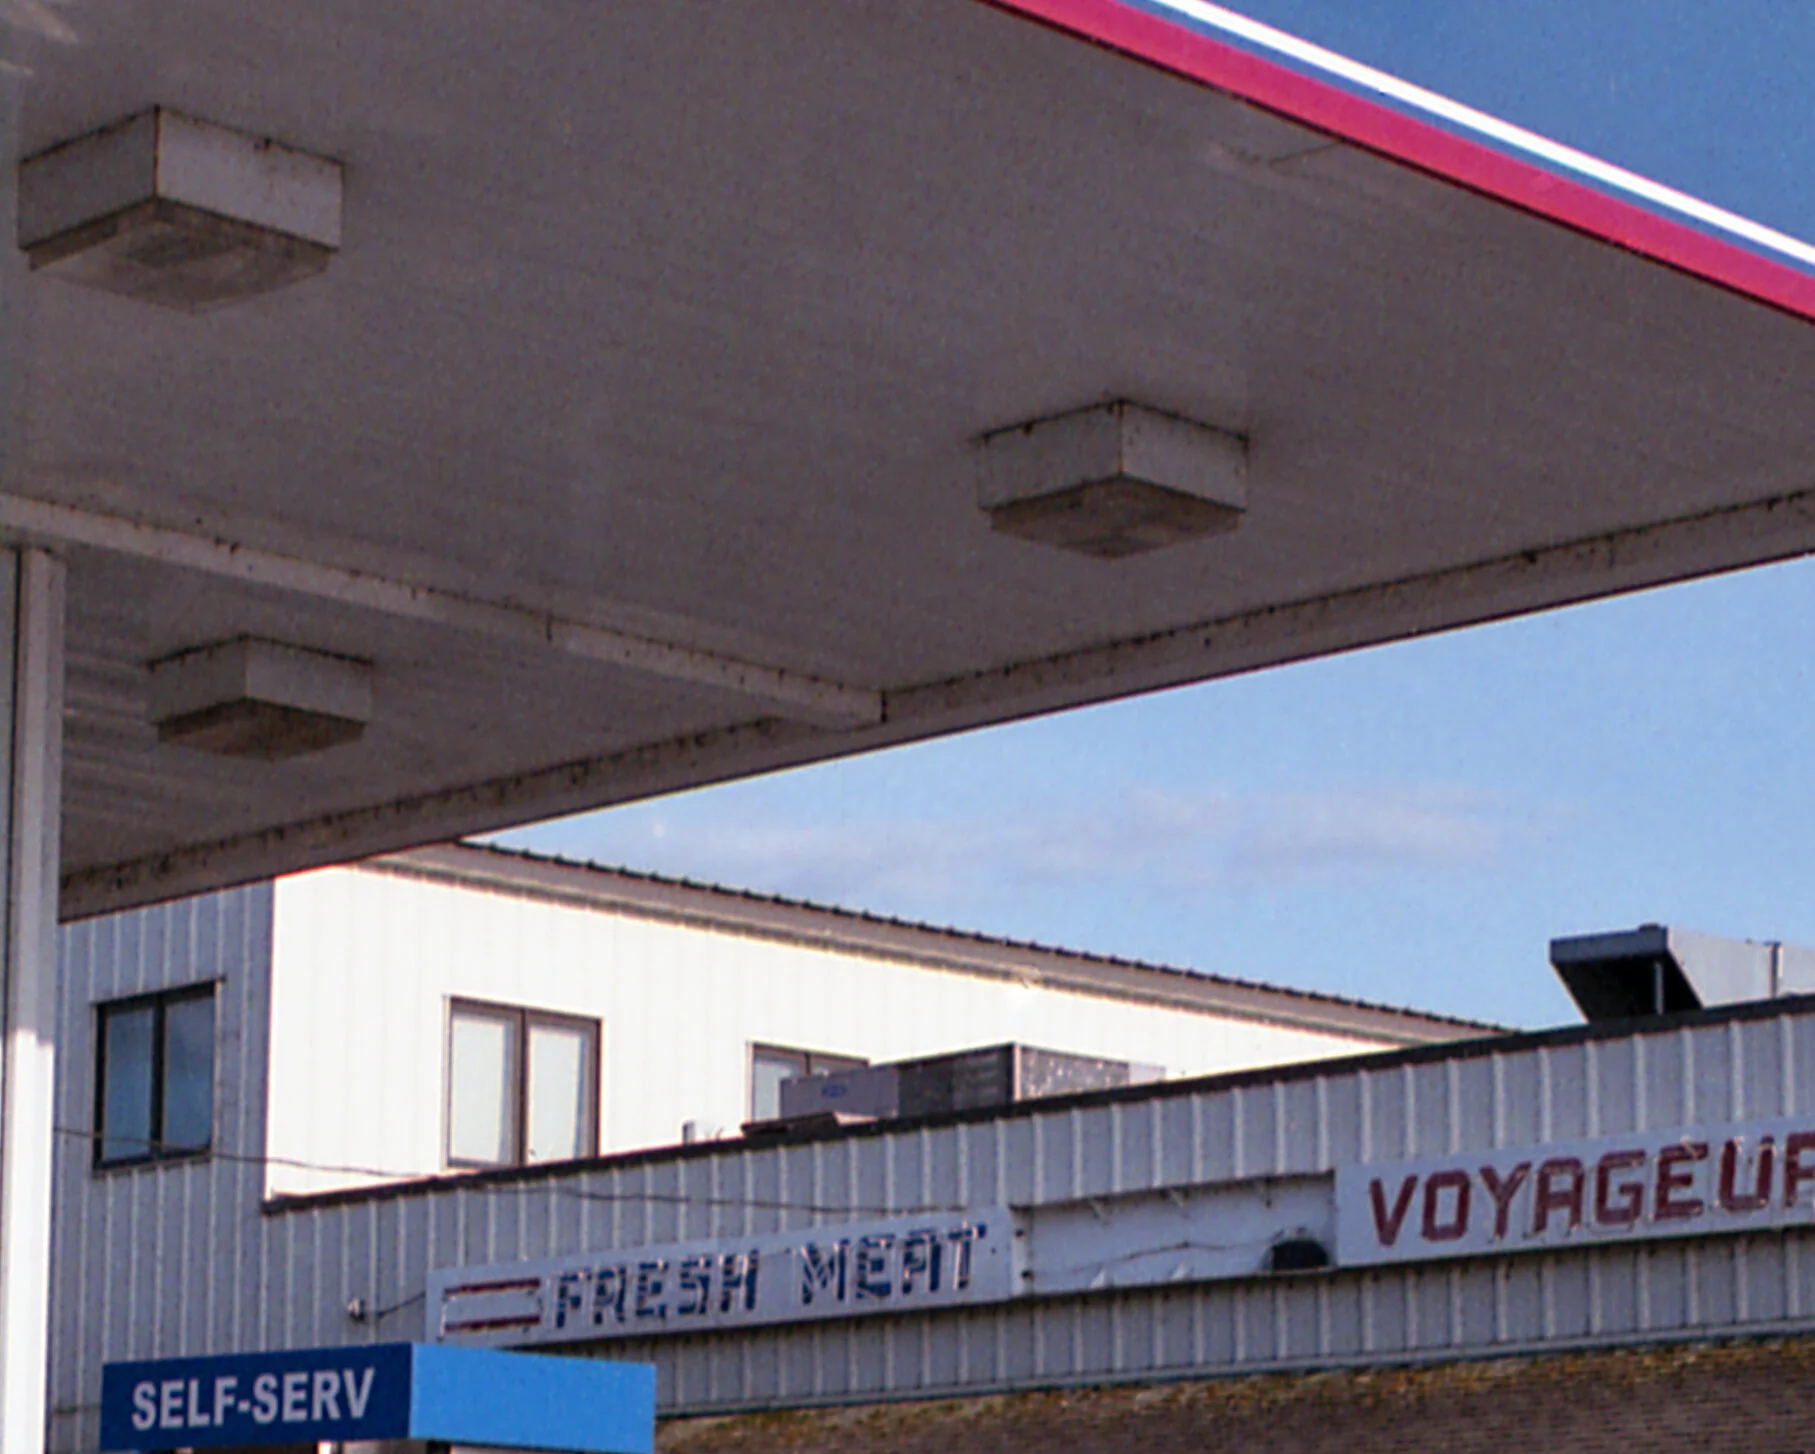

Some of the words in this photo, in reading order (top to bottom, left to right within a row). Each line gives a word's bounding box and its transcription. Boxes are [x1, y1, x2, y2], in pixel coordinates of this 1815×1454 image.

[553, 1248, 761, 1329] FRESH
[798, 1221, 988, 1305] MEAT
[132, 1368, 376, 1430] SELF-SERV
